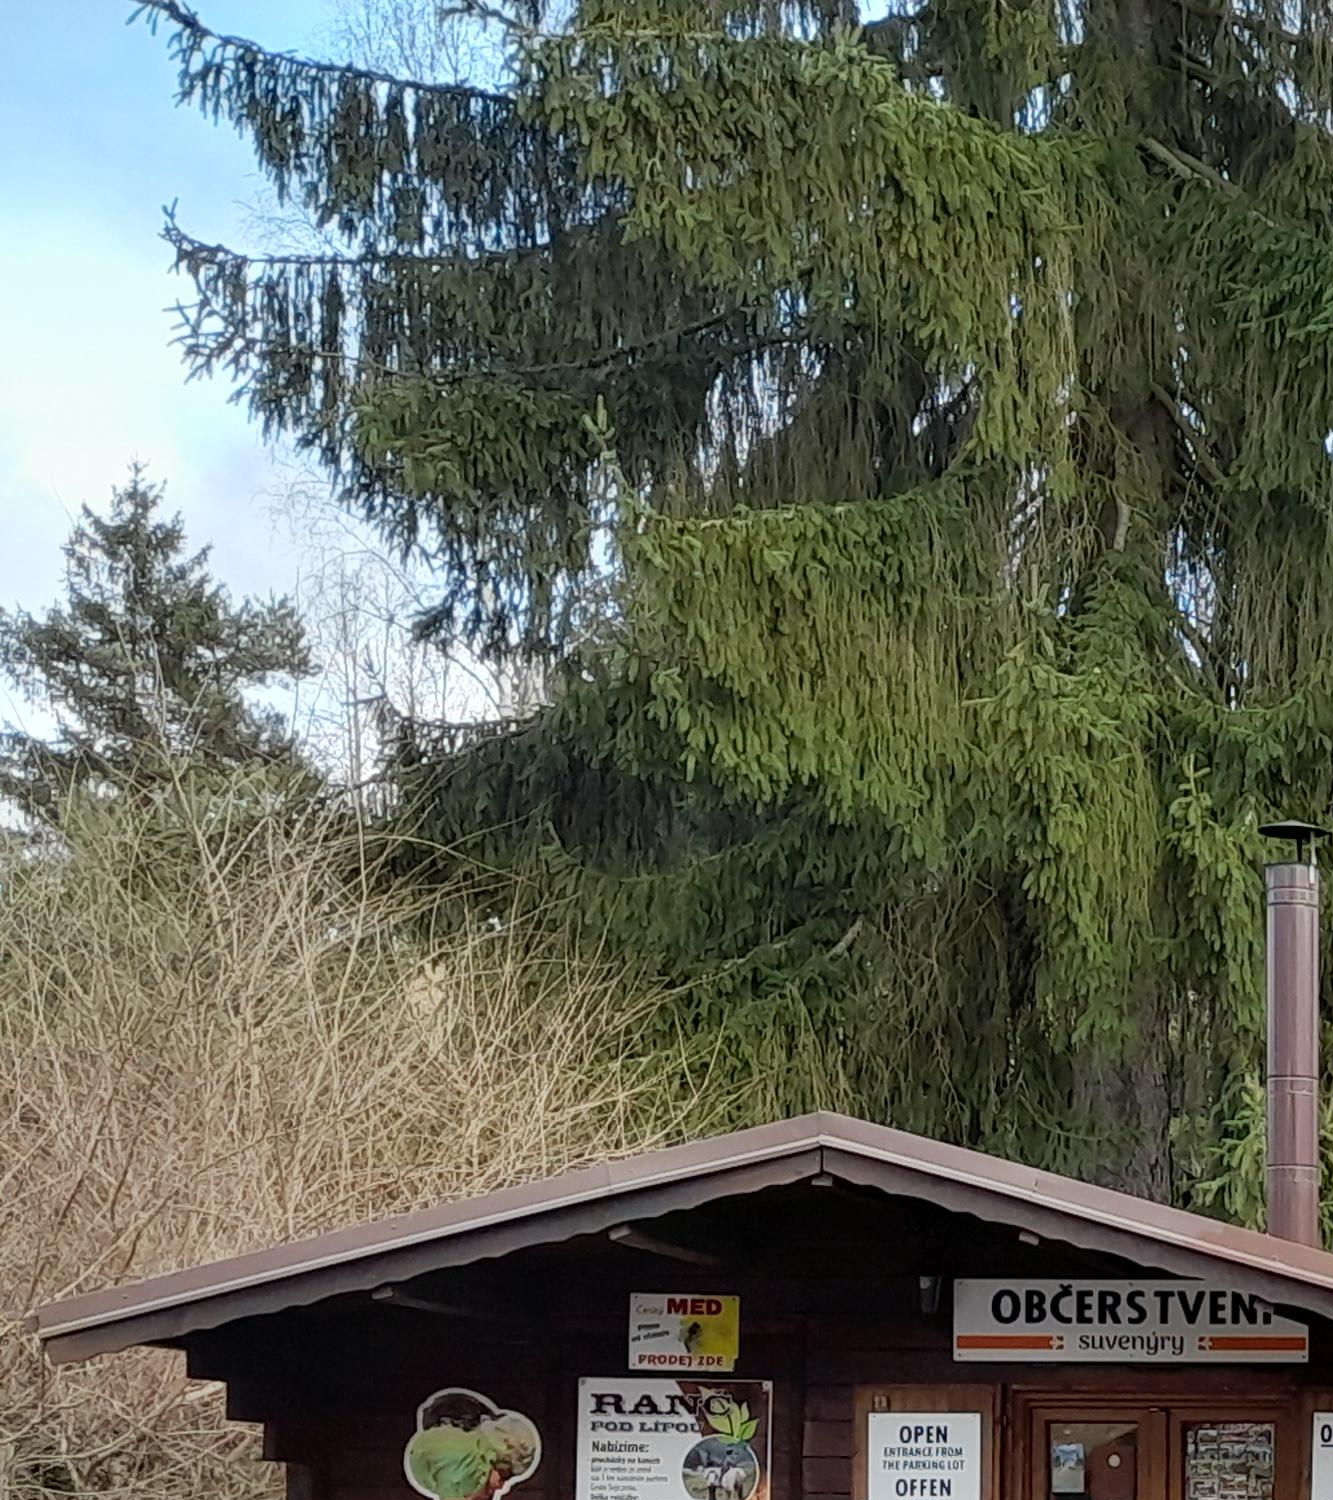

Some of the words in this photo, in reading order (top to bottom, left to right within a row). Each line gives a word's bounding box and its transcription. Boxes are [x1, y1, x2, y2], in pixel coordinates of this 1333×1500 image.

[667, 1298, 722, 1316] MED
[1079, 1331, 1184, 1356] suvenýry
[638, 1354, 692, 1367] PRODEJ
[698, 1355, 724, 1367] ZDE
[590, 1421, 633, 1433] POD
[900, 1425, 948, 1444] OPEN
[884, 1447, 933, 1457] ENTRANCE
[936, 1447, 963, 1457] FROM
[883, 1460, 901, 1470] THE
[903, 1460, 945, 1470] PARKING
[948, 1460, 965, 1470] LOT
[895, 1478, 952, 1497] OFFEN
